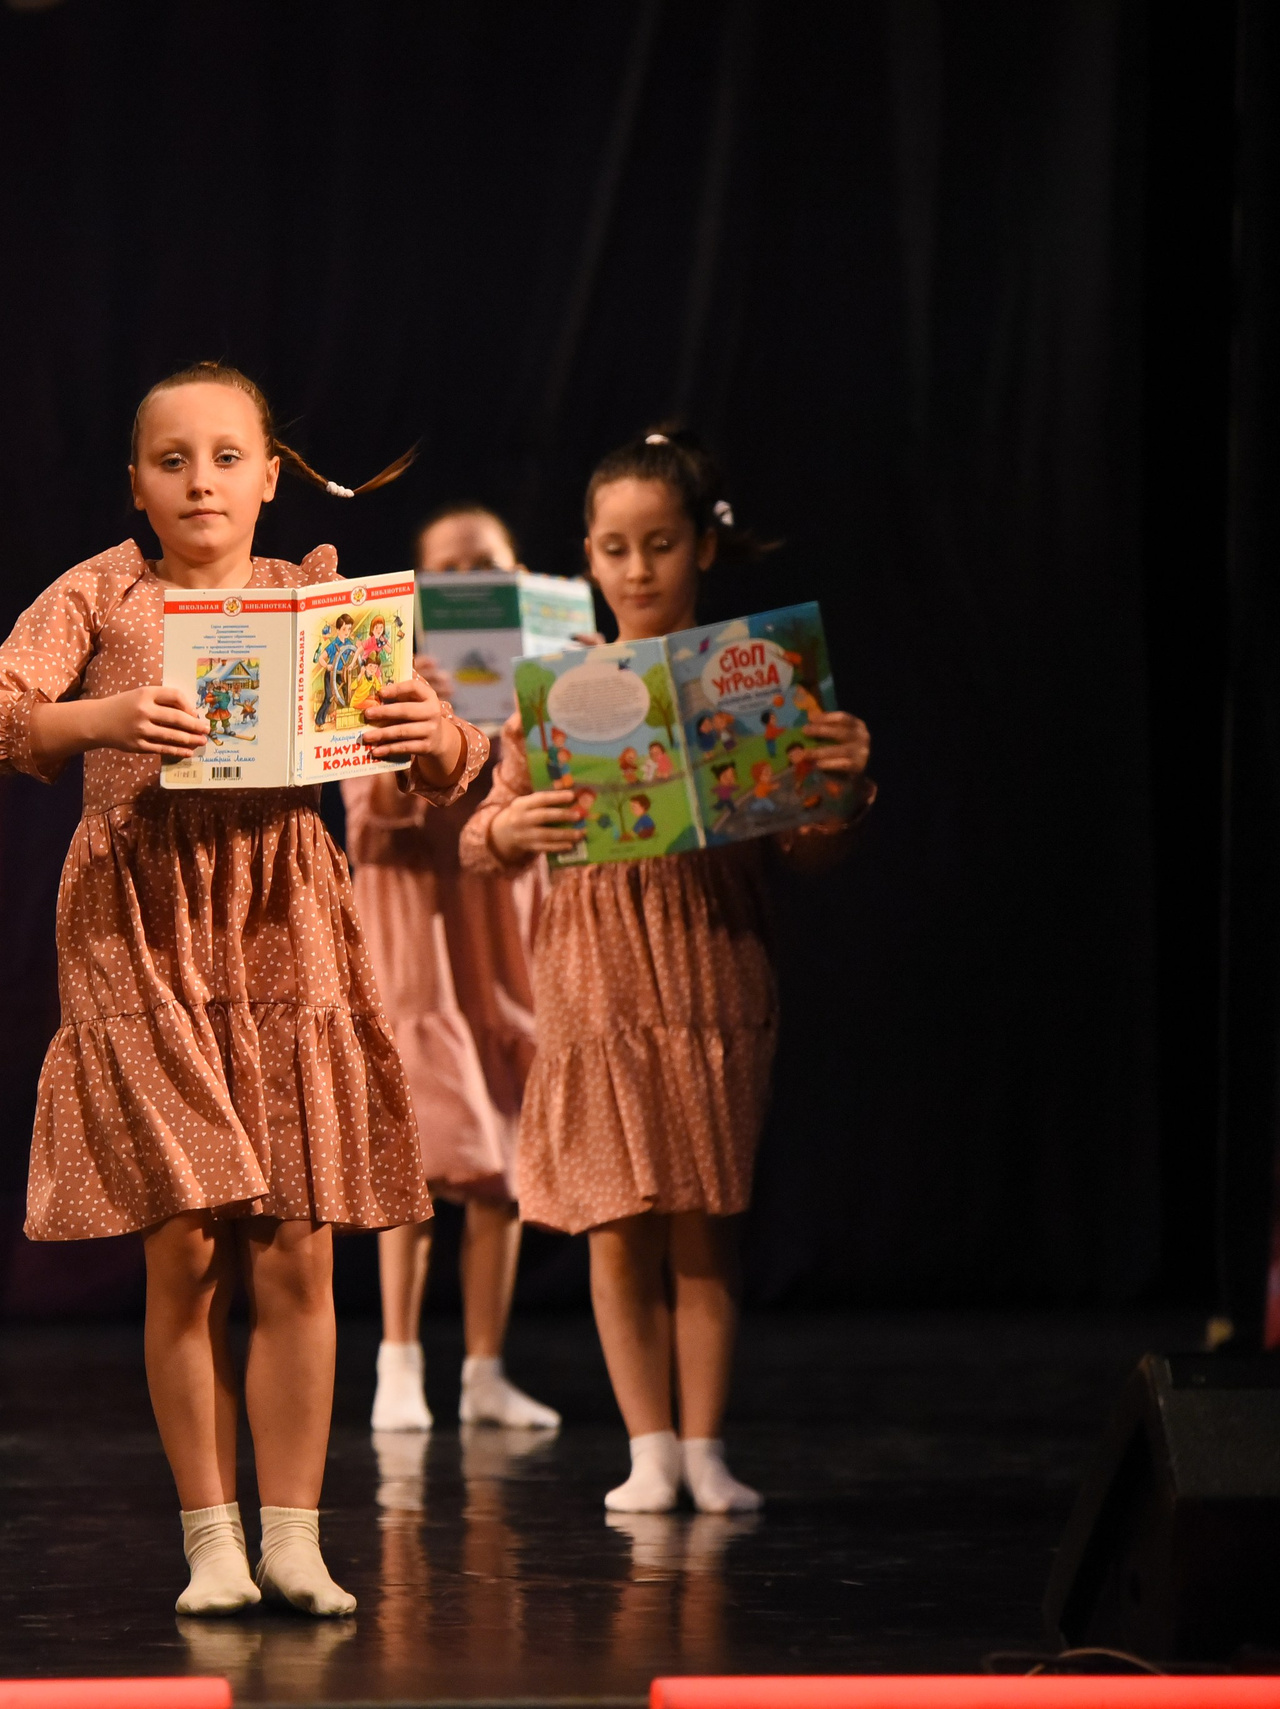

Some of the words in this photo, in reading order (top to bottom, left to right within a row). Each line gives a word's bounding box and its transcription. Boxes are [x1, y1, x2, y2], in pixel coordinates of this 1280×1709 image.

[311, 595, 346, 606] ШКОЛЬНАЯ
[371, 586, 411, 597] БИБЛИОТЕКА
[178, 601, 220, 611] ШКОЛЬНАЯ
[245, 602, 292, 610] БИБЛИОТЕКА
[313, 743, 361, 759] Тимур
